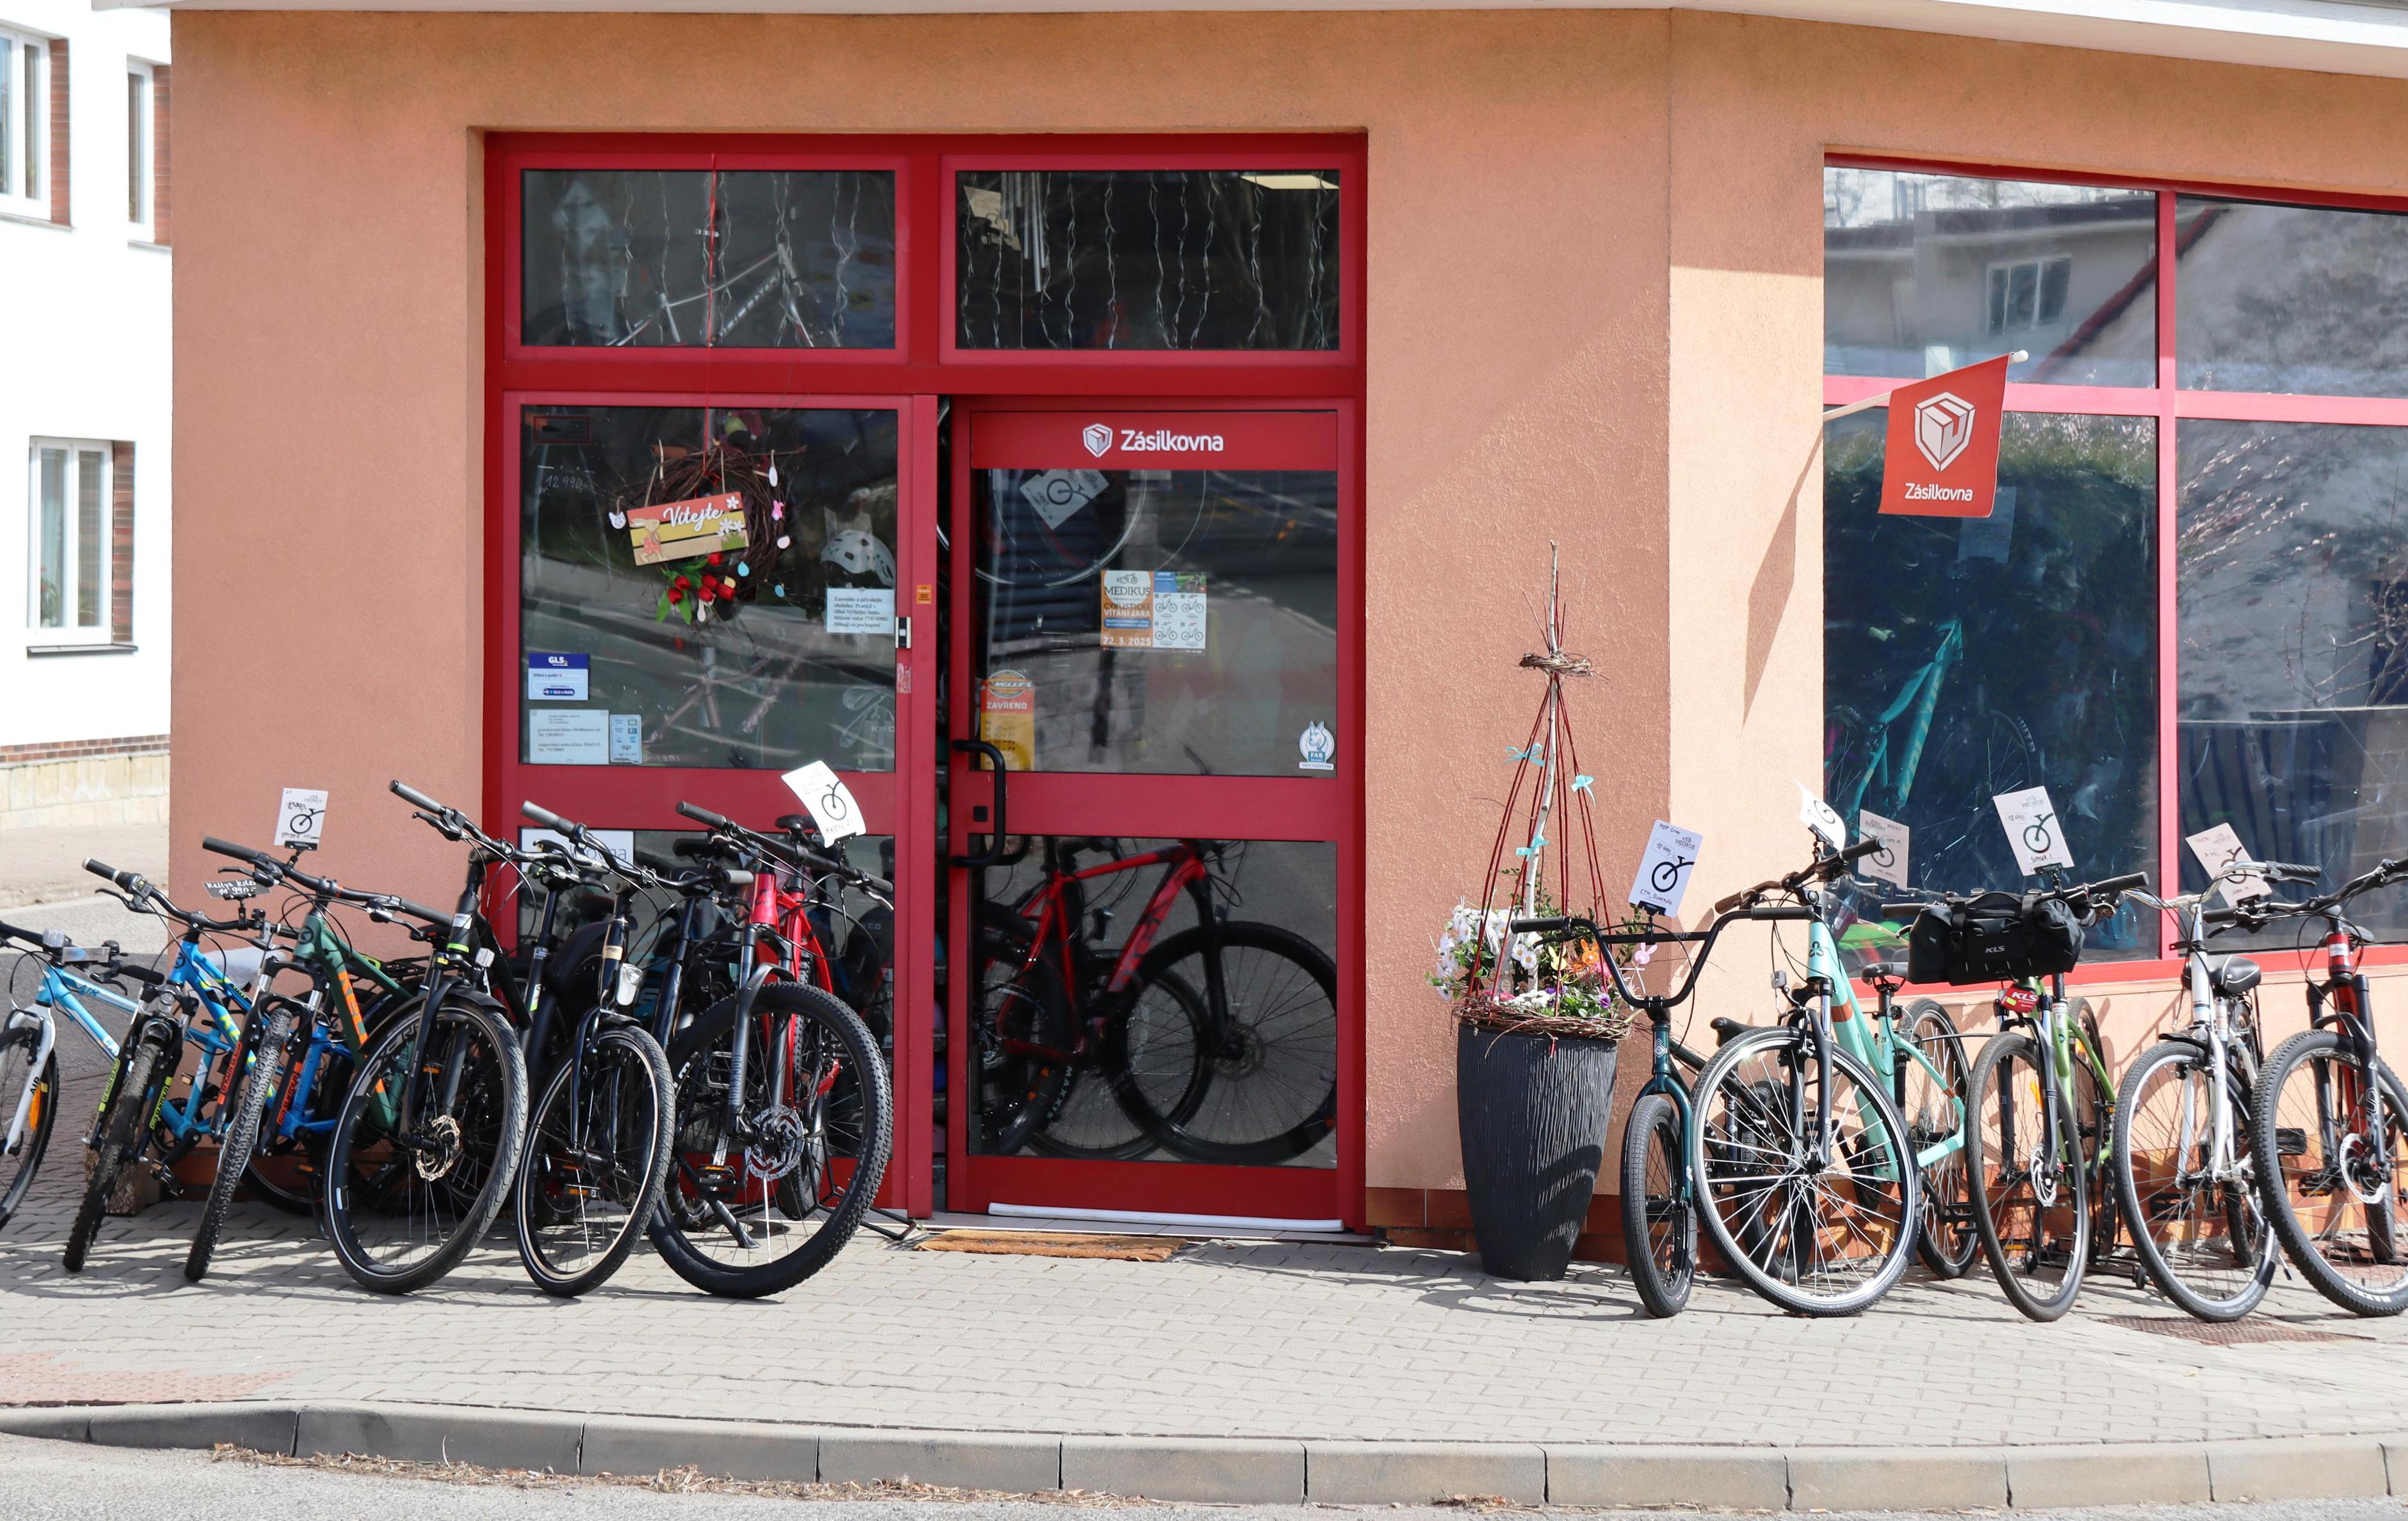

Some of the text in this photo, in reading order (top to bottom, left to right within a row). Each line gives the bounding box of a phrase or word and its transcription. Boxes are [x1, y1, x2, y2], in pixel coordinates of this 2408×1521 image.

[1120, 429, 1224, 452] Zásilkovna
[1905, 482, 1973, 502] Zásilkovna
[1104, 586, 1151, 596] MEDIKUS
[987, 701, 1028, 710] ZAVŘENO
[1675, 839, 1696, 850] MEDIKUS
[206, 882, 234, 890] Kellys
[1985, 945, 2005, 953] KLS
[2011, 991, 2038, 1003] KLS
[29, 1076, 42, 1096] AIR
[727, 1054, 742, 1107] ROCKSHOX
[1047, 1065, 1073, 1119] MAXXIS
